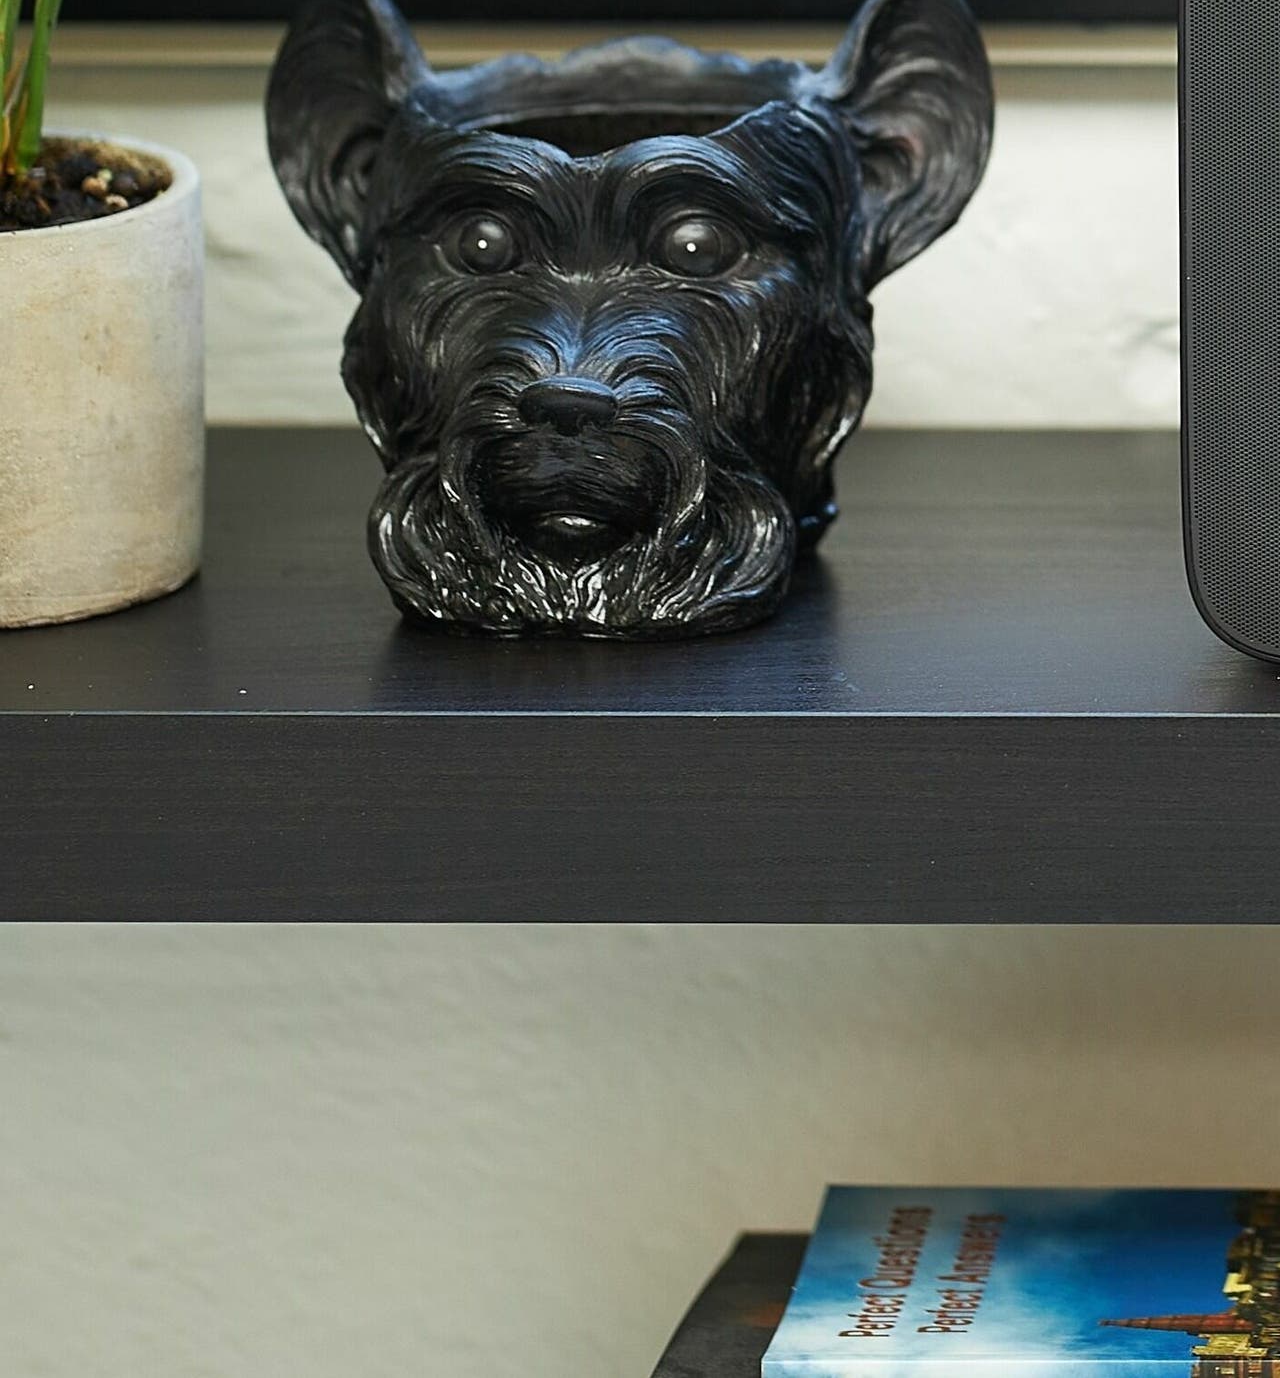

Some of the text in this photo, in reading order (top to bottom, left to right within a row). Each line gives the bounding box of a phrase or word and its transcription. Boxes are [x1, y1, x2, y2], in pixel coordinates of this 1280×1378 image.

[838, 1206, 934, 1337] Perfect Questions
[917, 1214, 1007, 1333] Perfect Answers
